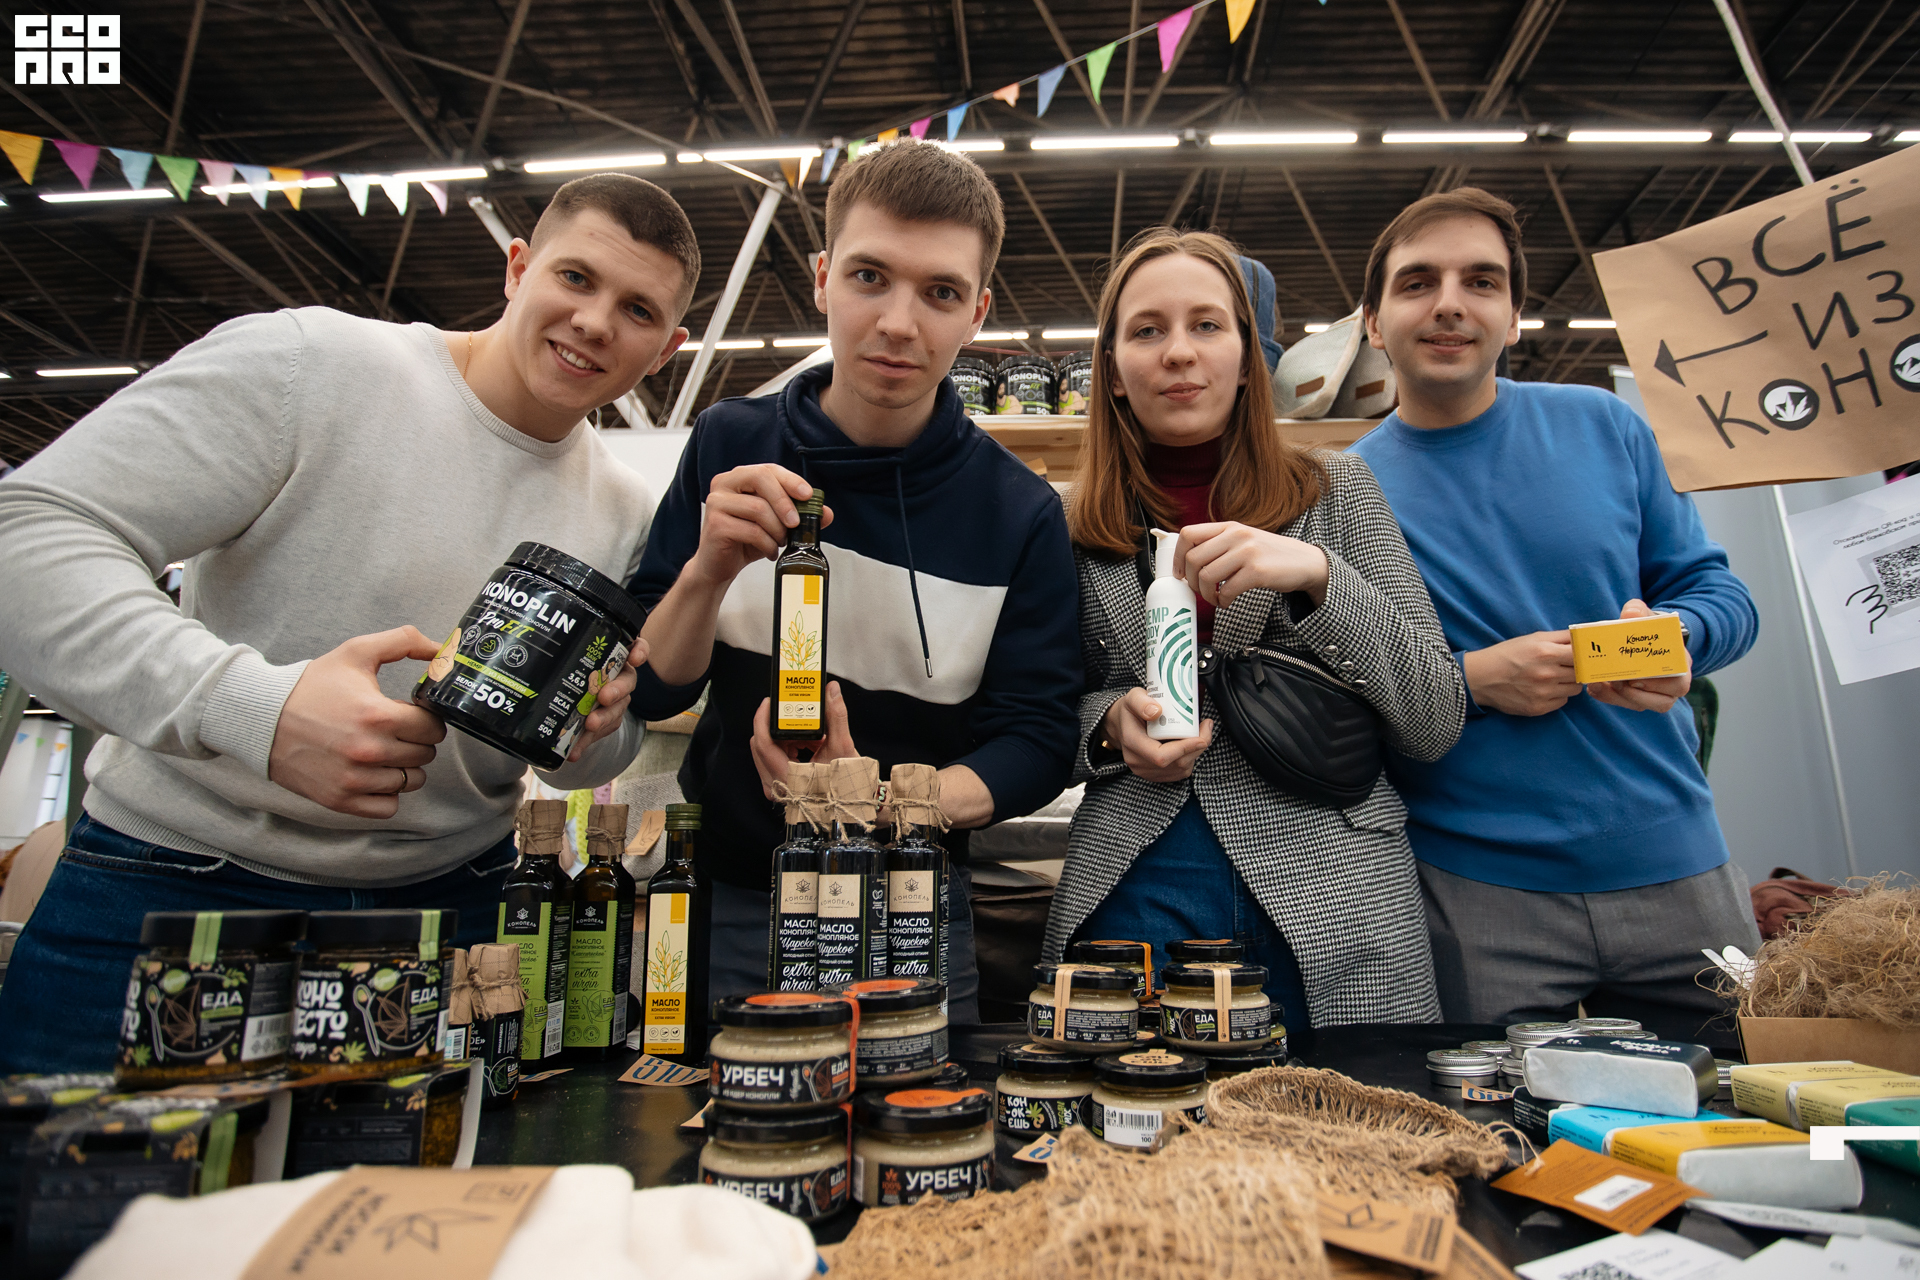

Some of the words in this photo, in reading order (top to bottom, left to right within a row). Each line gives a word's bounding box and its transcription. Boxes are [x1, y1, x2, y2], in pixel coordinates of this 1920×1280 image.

[1692, 177, 1886, 316] ВСЁ
[1791, 270, 1915, 351] ИЗ
[1008, 372, 1050, 383] KONOPLIN
[481, 580, 577, 635] KONOPLIN
[1626, 633, 1660, 645] Конопля
[568, 672, 586, 688] 3,6,9
[786, 676, 816, 685] МАСЛО
[455, 675, 479, 690] БЕЛОК
[473, 683, 517, 713] 50%
[553, 696, 571, 711] BCAA
[537, 723, 553, 736] 500
[893, 894, 930, 902] КОНОПЕЛЬ
[507, 920, 537, 928] КОНОПЕЛЬ
[820, 923, 854, 933] МАСЛО
[893, 917, 930, 927] МАСЛО
[574, 967, 599, 978] extra
[893, 959, 929, 975] extra
[818, 968, 853, 984] extra
[571, 979, 599, 992] virgin
[202, 990, 243, 1010] ЕДА
[410, 987, 439, 1004] ЕДА
[533, 1005, 548, 1013] ЕДА
[651, 998, 681, 1007] МАСЛО
[1037, 1010, 1053, 1020] ЕДА
[1194, 1013, 1215, 1024] ЕДА
[831, 1058, 850, 1076] ЕДА
[722, 1063, 786, 1087] УРБЕЧ
[745, 1090, 782, 1100] КОНОПЛИ
[1007, 1096, 1028, 1107] КОН
[1063, 1108, 1073, 1125] MIX
[905, 1165, 972, 1192] УРБЕЧ
